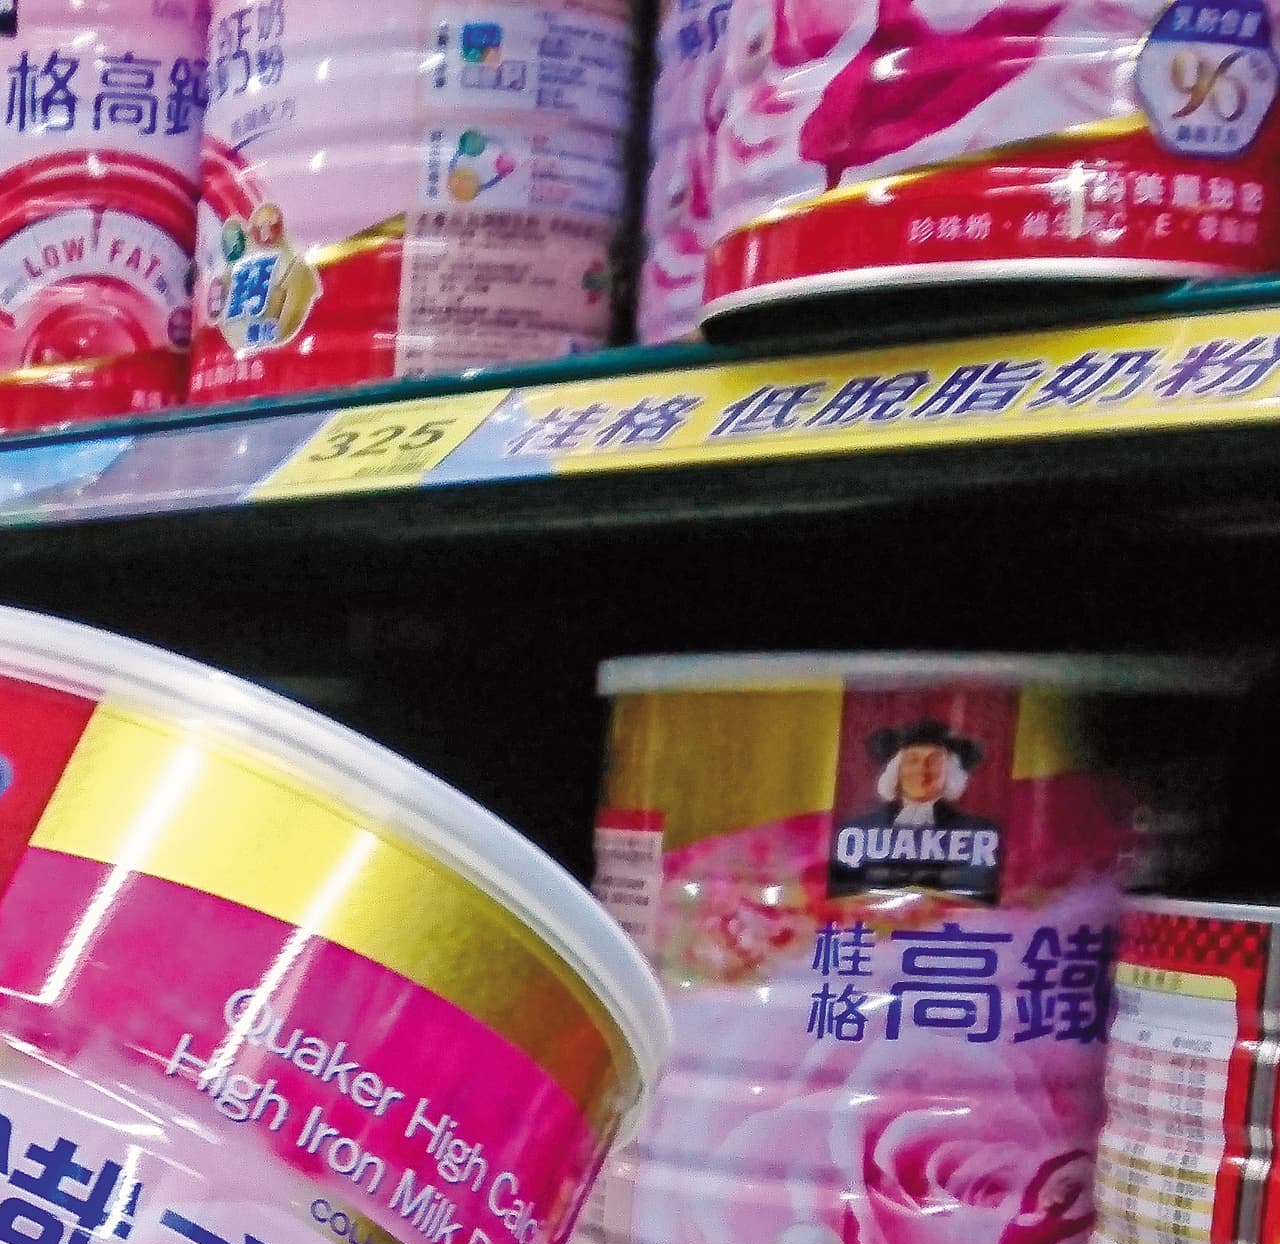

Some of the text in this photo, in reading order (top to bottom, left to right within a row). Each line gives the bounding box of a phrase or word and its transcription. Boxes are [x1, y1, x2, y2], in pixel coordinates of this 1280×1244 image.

[23, 235, 162, 281] LOW FAT
[308, 417, 460, 464] 325
[706, 334, 1280, 442] 低脫脂奶粉
[836, 826, 1000, 869] QUAKER
[806, 920, 876, 1043] 桂格
[884, 921, 1119, 1045] 高鐵
[165, 1031, 290, 1132] High
[296, 1104, 388, 1195] Iron
[223, 987, 405, 1118] Quaker
[404, 1097, 491, 1193] High
